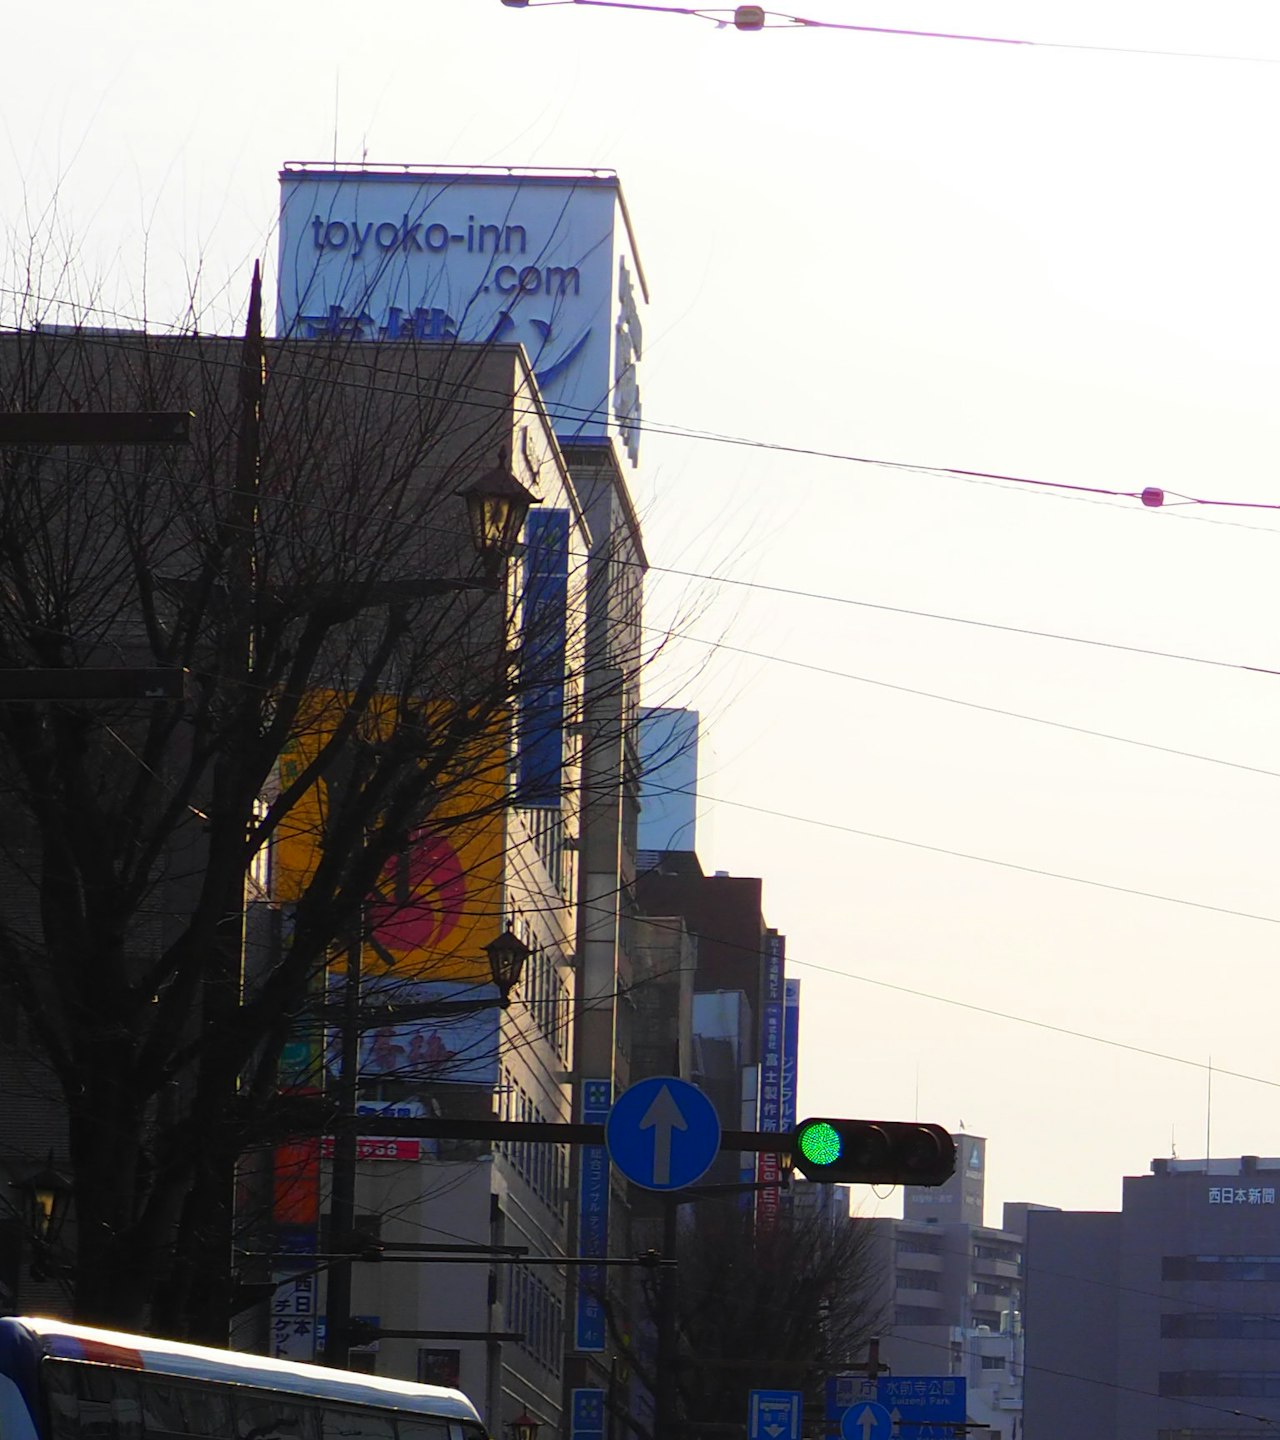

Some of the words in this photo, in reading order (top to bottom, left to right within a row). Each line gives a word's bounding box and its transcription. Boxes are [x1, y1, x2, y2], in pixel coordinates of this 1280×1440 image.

[311, 213, 527, 259] toyoko-inn
[482, 263, 581, 296] .com
[1208, 1187, 1276, 1205] 西日本新聞
[273, 1299, 291, 1358] チケット
[886, 1380, 957, 1396] 水前寺公園
[929, 1396, 951, 1405] Park
